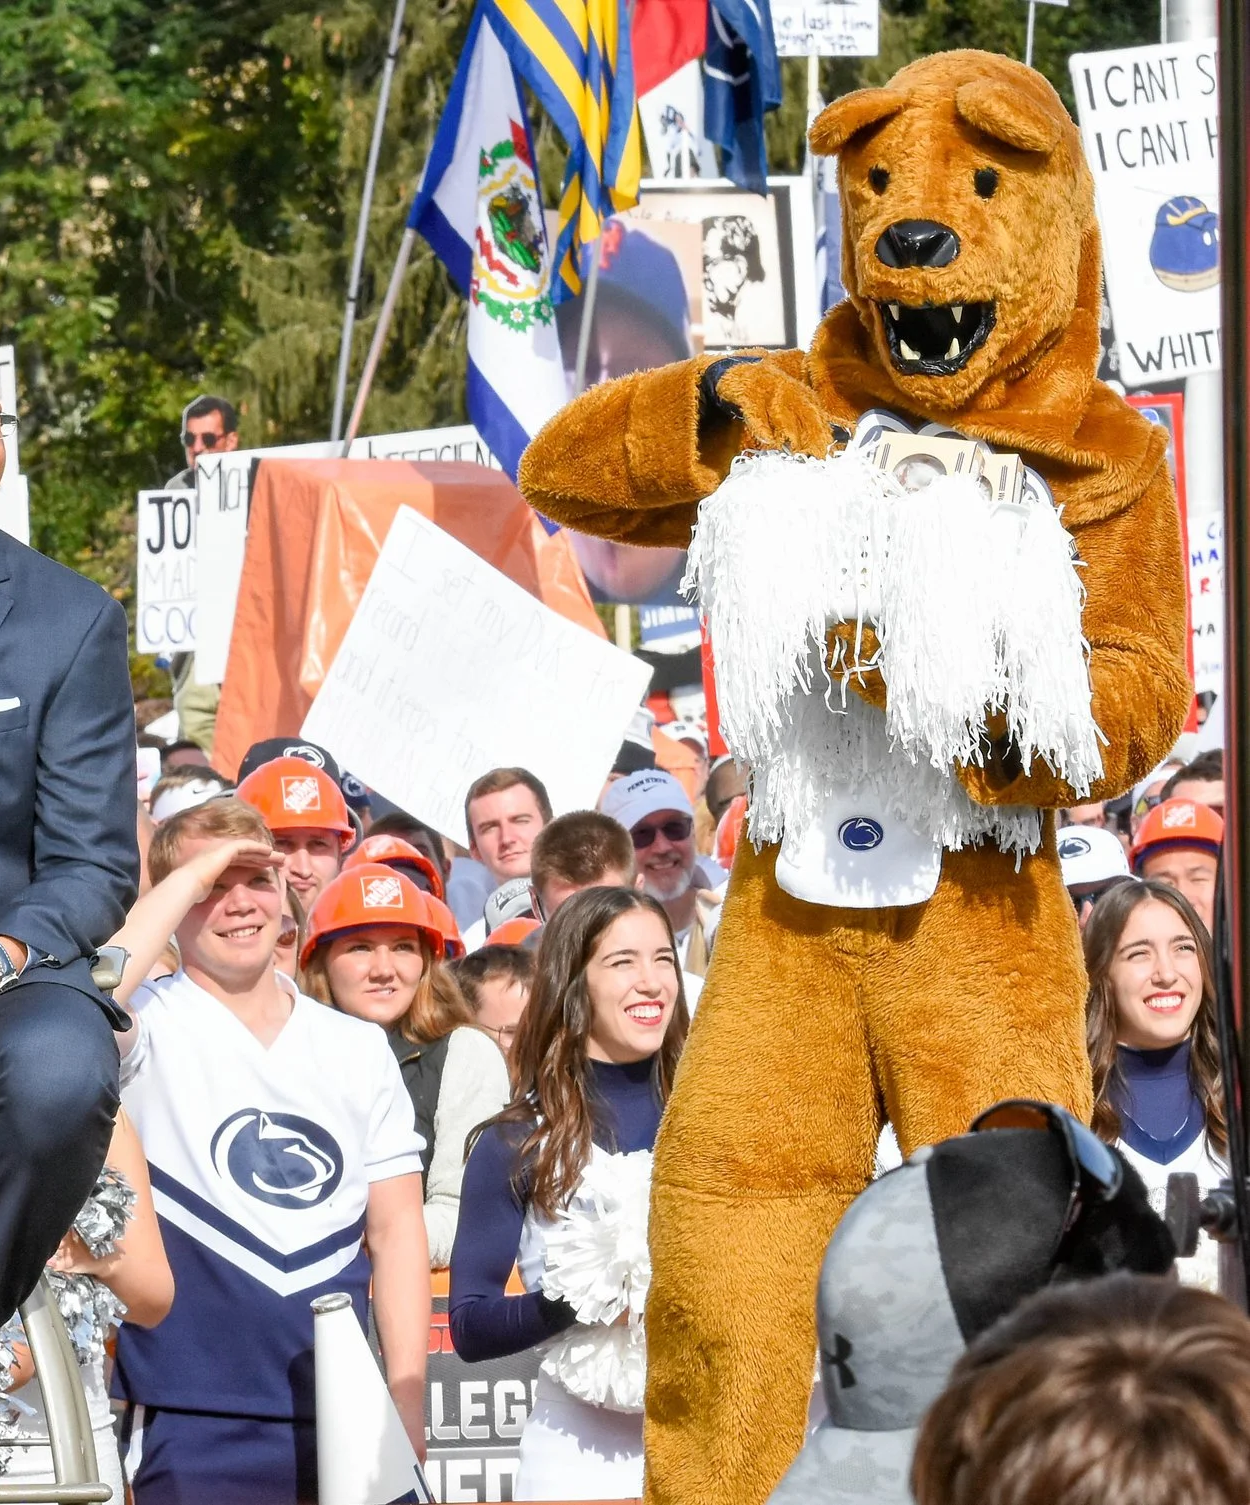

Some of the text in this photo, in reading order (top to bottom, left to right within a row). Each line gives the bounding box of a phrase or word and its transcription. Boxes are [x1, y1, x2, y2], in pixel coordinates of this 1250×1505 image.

[1083, 68, 1098, 111] I
[1104, 56, 1181, 109] CANT
[1095, 131, 1108, 172] I
[1116, 120, 1191, 169] CANT
[1126, 329, 1220, 373] WHIT
[432, 563, 476, 613] set
[626, 780, 645, 793] PENN
